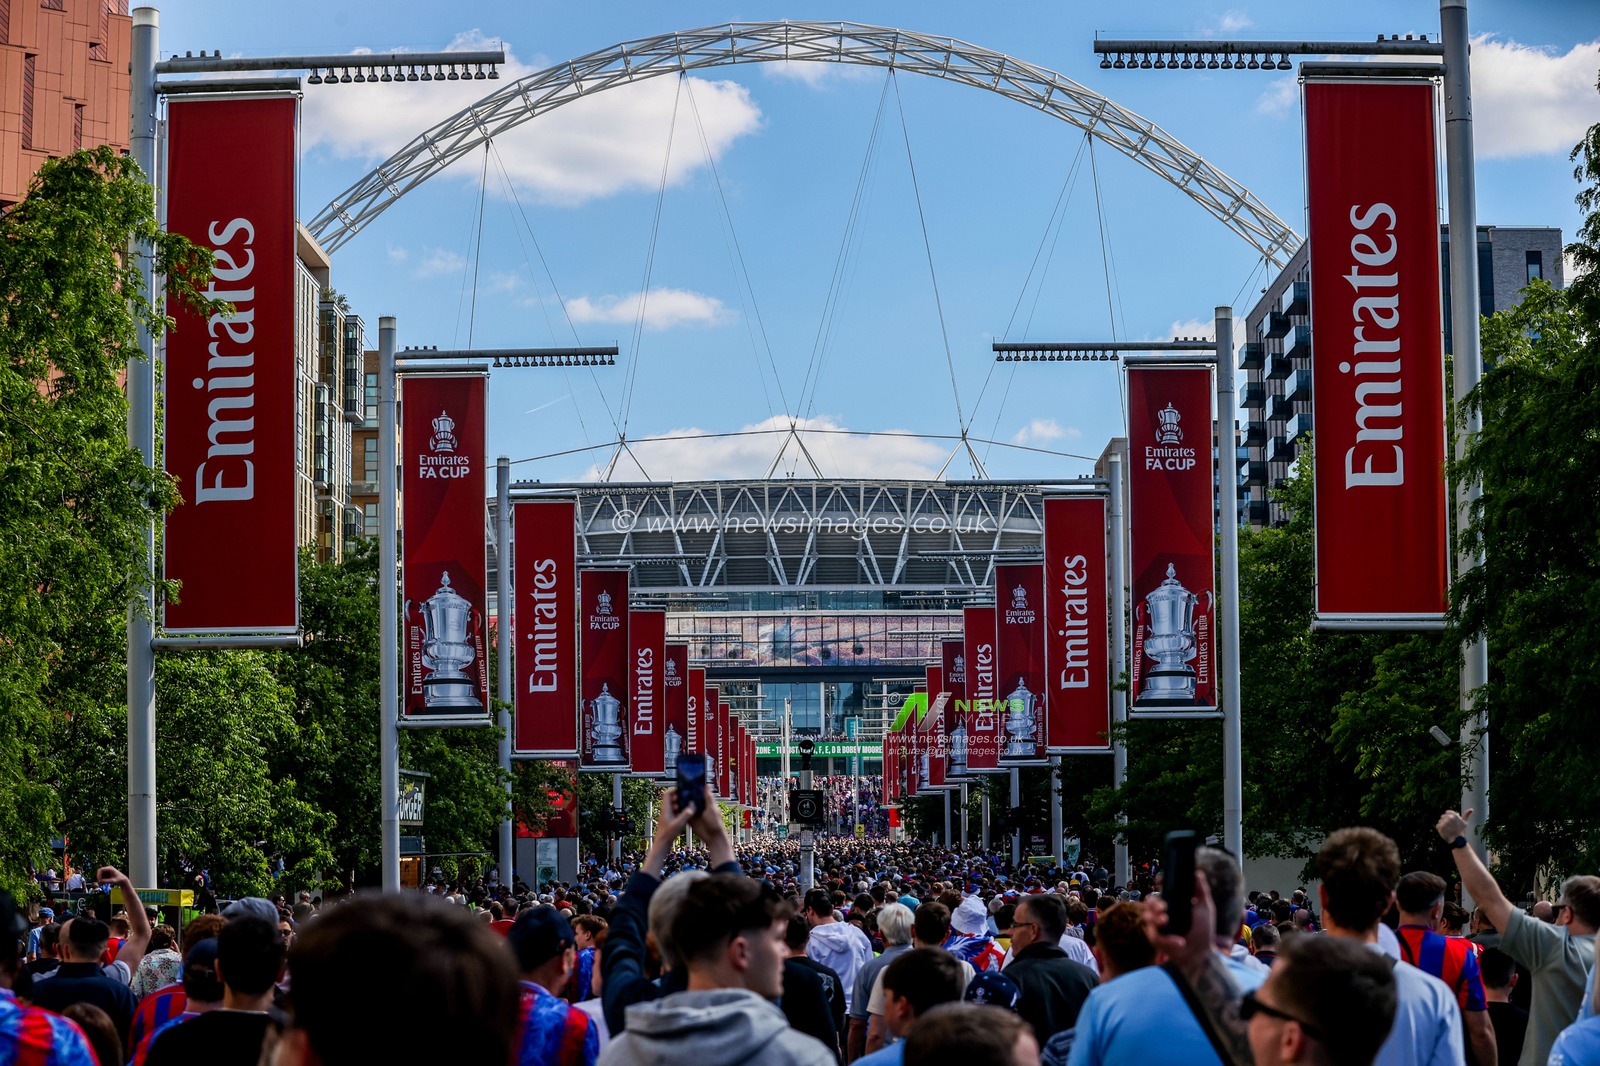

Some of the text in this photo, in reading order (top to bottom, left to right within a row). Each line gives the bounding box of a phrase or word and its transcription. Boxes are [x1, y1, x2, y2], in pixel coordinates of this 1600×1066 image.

[192, 216, 256, 506] Emirates
[1338, 202, 1405, 491] Emirates
[419, 454, 470, 466] Emirates
[1145, 446, 1196, 457] Emirates
[1145, 458, 1196, 470] FA CUP
[419, 466, 470, 479] FA CUP
[528, 558, 558, 694] Emirates
[590, 622, 620, 630] FA CUP
[1005, 616, 1036, 625] FA CUP
[1058, 554, 1089, 690] Emirates
[411, 651, 423, 695] Emirates
[479, 659, 488, 693] Emirates
[1132, 649, 1142, 682] Emirates
[1197, 641, 1208, 684] Emirates
[633, 647, 653, 736] Emirates
[974, 642, 994, 732] Emirates
[756, 745, 771, 755] ZONE
[862, 745, 883, 754] MOORE
